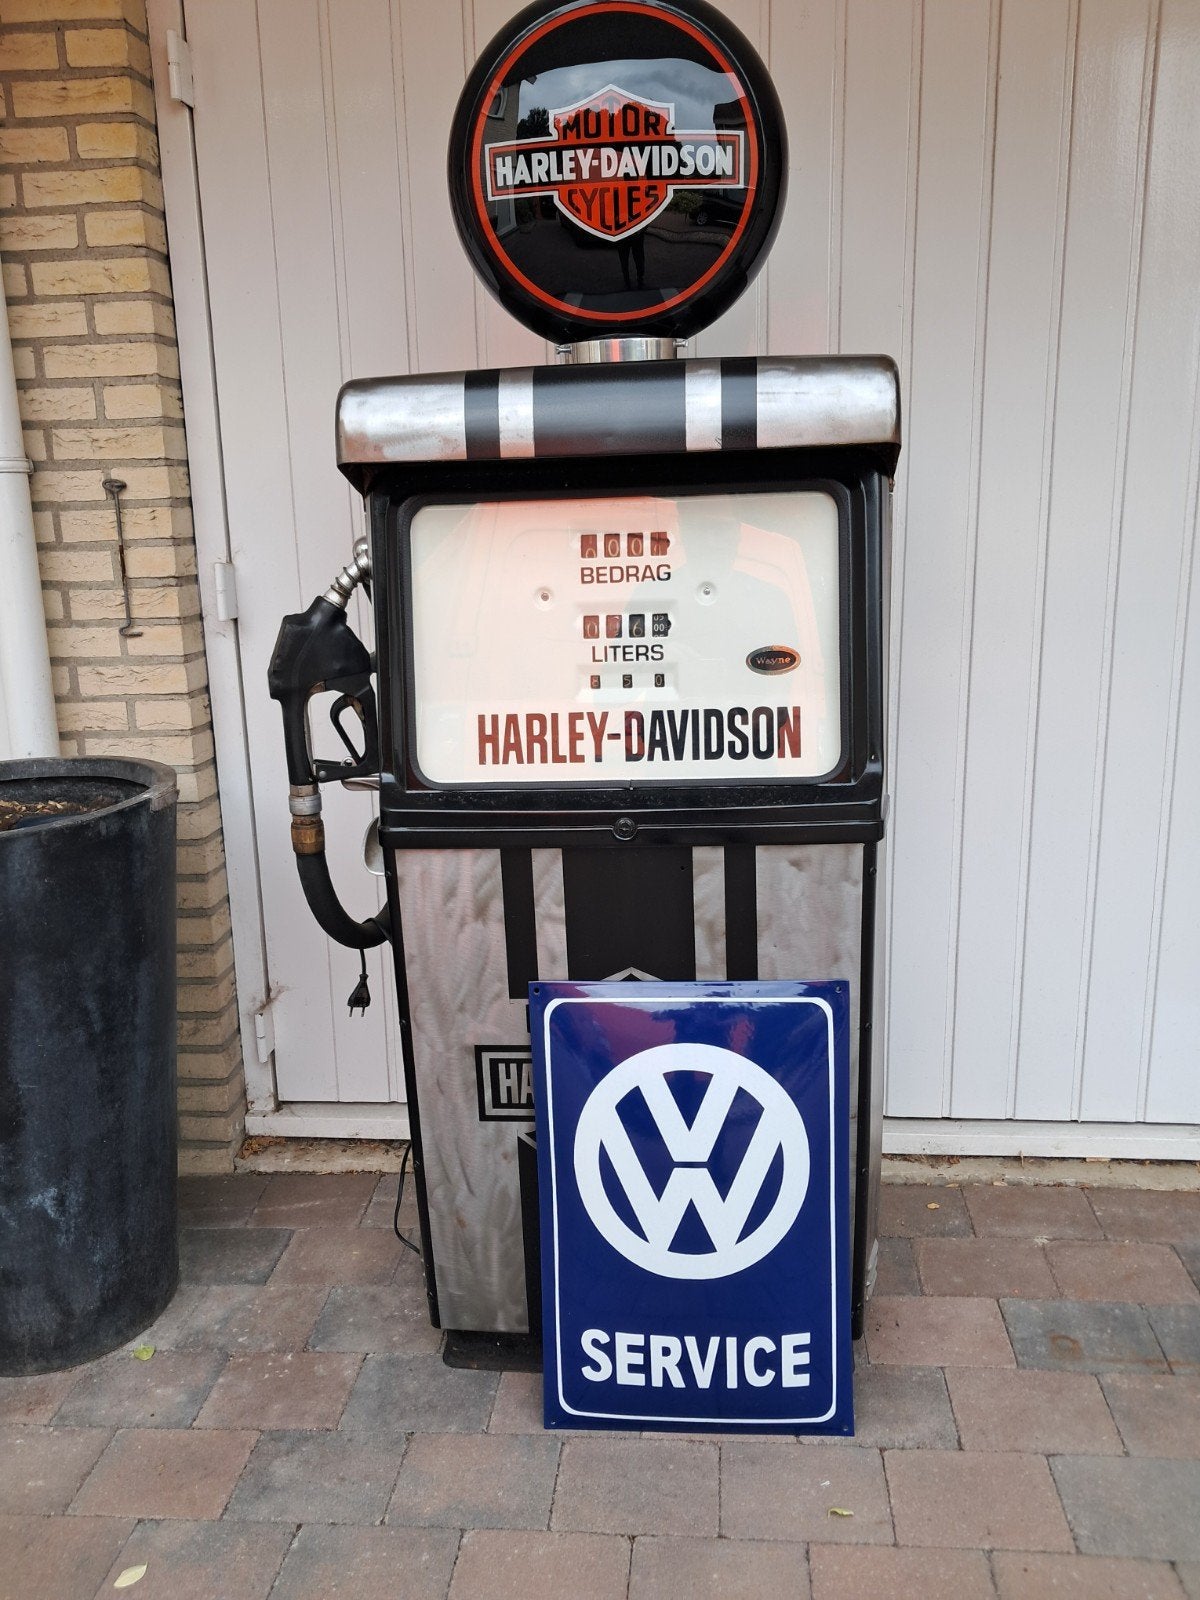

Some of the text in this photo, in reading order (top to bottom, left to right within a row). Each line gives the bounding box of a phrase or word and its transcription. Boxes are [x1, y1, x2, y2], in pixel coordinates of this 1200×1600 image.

[562, 95, 661, 140] MOTOR
[495, 144, 734, 187] HARLEY-DAVIDSON
[566, 185, 660, 231] CYCLES
[580, 564, 671, 584] BEDRAG
[592, 644, 664, 663] LITERS
[756, 656, 791, 665] Wayne
[477, 706, 802, 765] HARLEY-DAVIDSON
[580, 1328, 811, 1389] SERVICE
